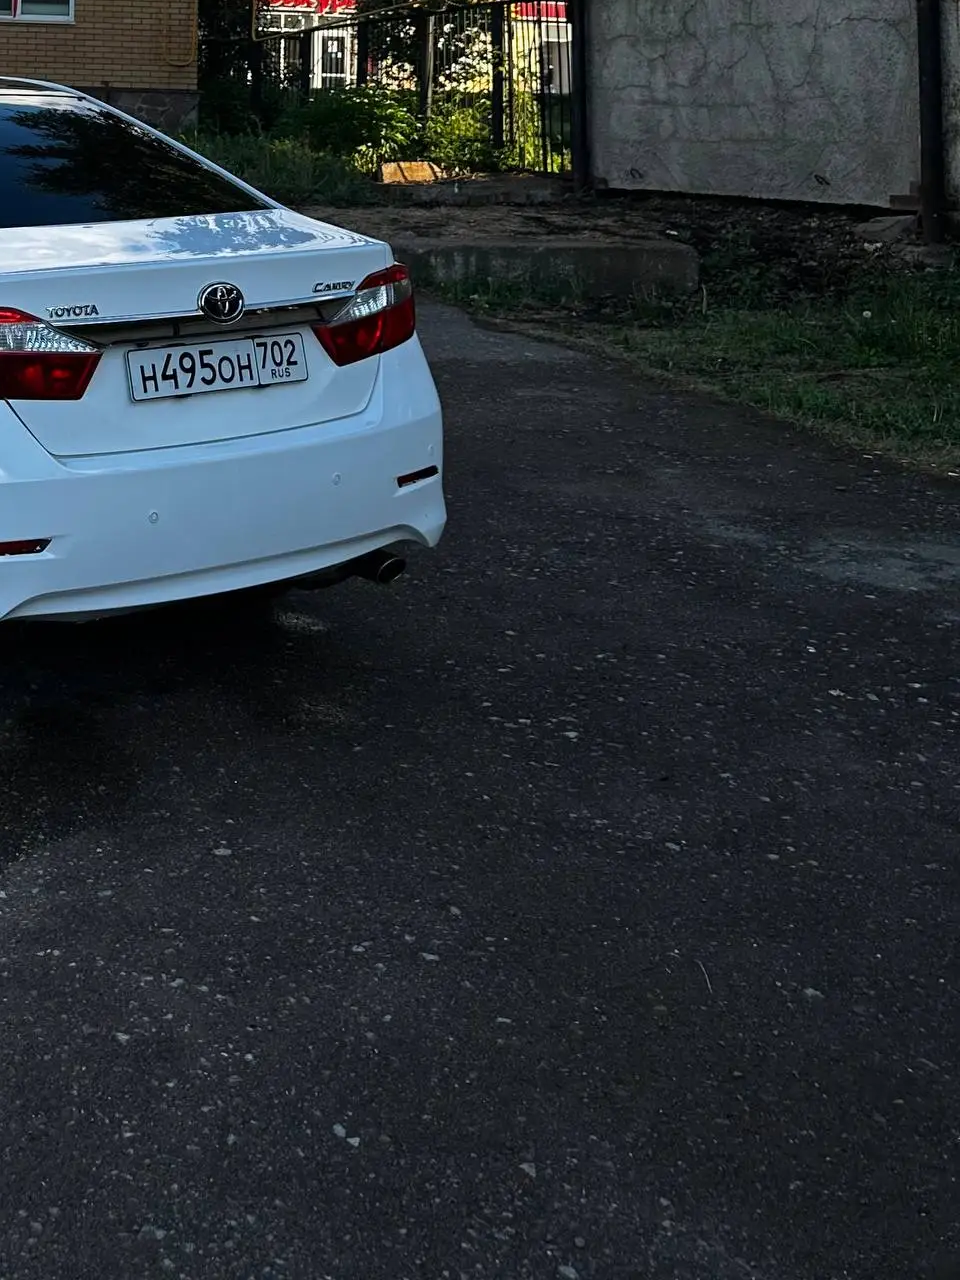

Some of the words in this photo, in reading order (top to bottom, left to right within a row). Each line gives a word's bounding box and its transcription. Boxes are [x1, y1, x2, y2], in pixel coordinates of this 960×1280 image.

[46, 304, 100, 319] TOYOTA
[256, 339, 298, 369] 702
[271, 367, 291, 379] RUS
